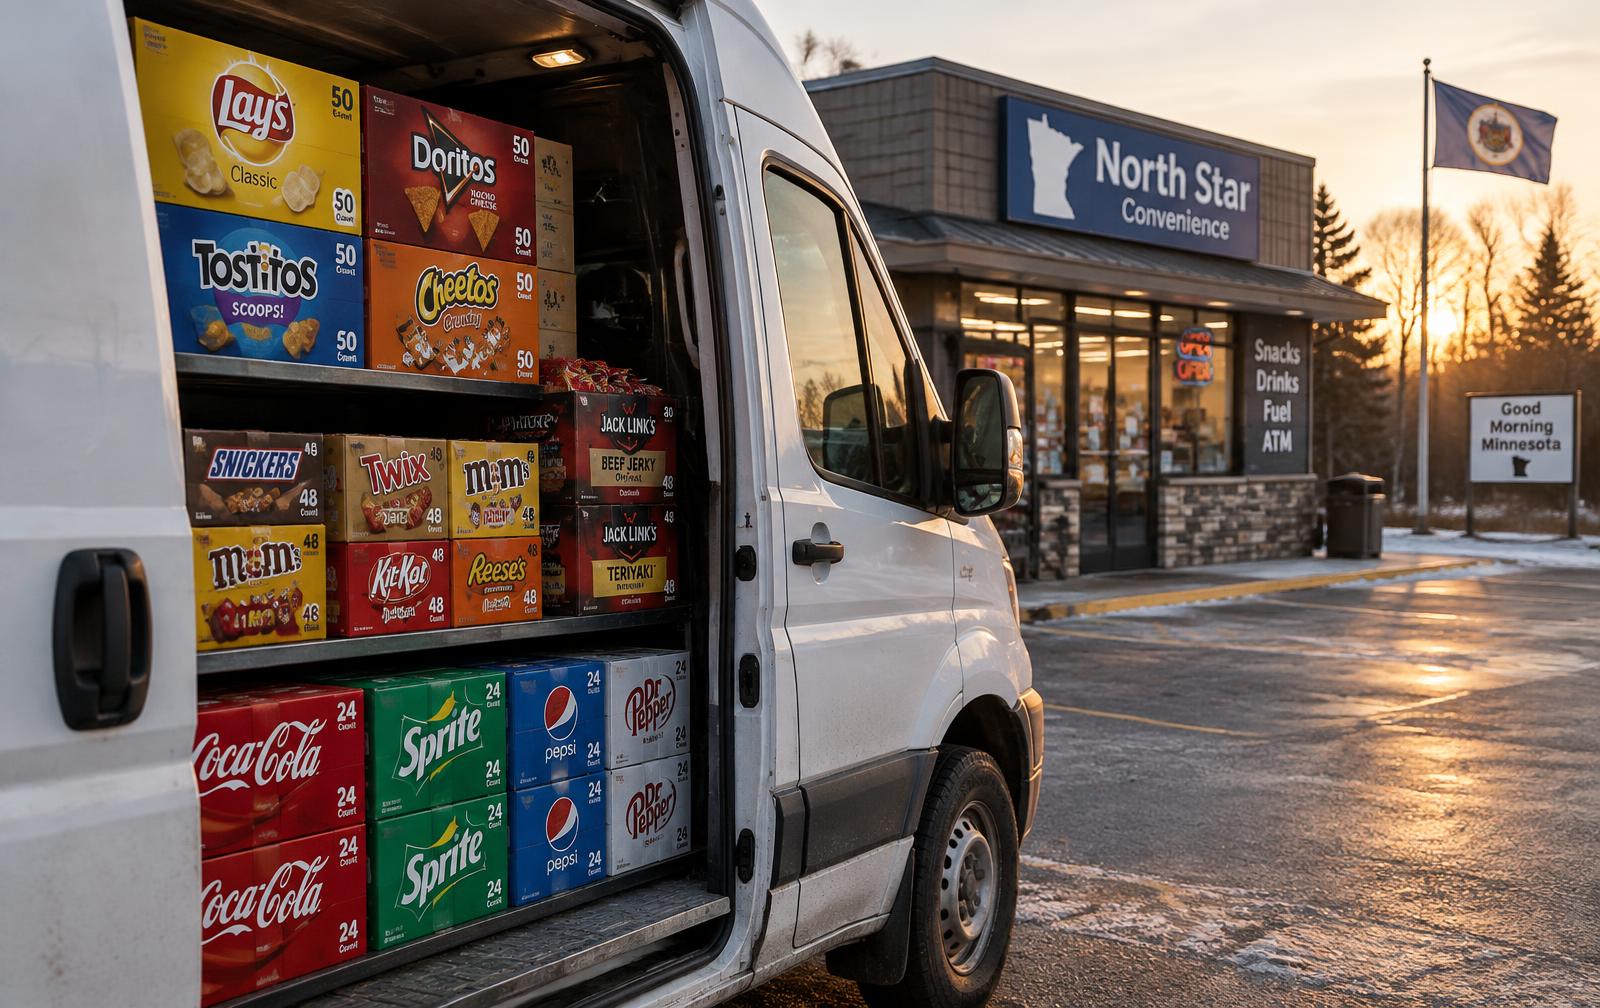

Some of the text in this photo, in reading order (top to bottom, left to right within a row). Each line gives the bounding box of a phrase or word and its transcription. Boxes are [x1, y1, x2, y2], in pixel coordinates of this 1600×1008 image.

[332, 85, 353, 111] 50
[218, 79, 288, 140] Lay's
[513, 135, 529, 156] 50
[413, 135, 495, 184] Doritos
[231, 165, 277, 189] Classic
[1096, 137, 1251, 212] North Star
[335, 191, 354, 213] 50
[1122, 197, 1230, 240] Convenience
[515, 227, 531, 247] 50
[336, 243, 356, 266] 50
[517, 272, 532, 292] 50
[416, 264, 499, 323] Cheetos
[232, 302, 284, 318] SCOOPS!
[337, 331, 357, 351] 50
[517, 350, 533, 369] 50
[1255, 338, 1300, 365] Snacks
[1256, 369, 1299, 393] Drinks
[1263, 399, 1291, 422] Fuel
[1501, 401, 1541, 416] Good
[601, 414, 656, 435] JACK LINK'S
[1490, 419, 1554, 436] Morning
[304, 442, 317, 456] 48
[1262, 430, 1292, 453] ATM
[1481, 437, 1561, 451] Minnesota
[209, 450, 301, 478] SNICKERS
[360, 451, 431, 495] Twix
[602, 456, 656, 473] BEEF JERKY
[663, 475, 673, 490] 48
[300, 489, 317, 506] 48
[426, 508, 442, 523] 48
[522, 506, 534, 521] 48
[304, 534, 318, 549] 48
[603, 523, 657, 543] JACK LINK'S
[432, 548, 444, 562] 48
[528, 544, 538, 557] 48
[468, 553, 527, 587] Reese's
[607, 565, 654, 582] TERIYAKI
[524, 589, 536, 604] 48
[664, 579, 674, 594] 48
[303, 605, 319, 622] 48
[429, 597, 443, 613] 48
[676, 659, 686, 674] 24
[588, 670, 600, 687] 24
[486, 682, 501, 699] 24
[645, 678, 662, 701] Dr
[337, 700, 356, 722] 24
[629, 688, 671, 736] Pepper
[399, 705, 481, 781] Sprite
[676, 725, 686, 741] 24
[545, 739, 576, 763] pepsi
[588, 741, 600, 758] 24
[486, 760, 500, 778] 24
[678, 760, 688, 776] 24
[338, 786, 356, 807] 24
[589, 780, 601, 798] 24
[645, 782, 662, 808] Dr
[488, 803, 502, 821] 24
[630, 792, 673, 840] Pepper
[340, 836, 358, 857] 24
[401, 827, 483, 908] Sprite
[547, 849, 578, 875] pepsi
[589, 850, 602, 867] 24
[488, 879, 501, 898] 24
[339, 920, 358, 942] 24
